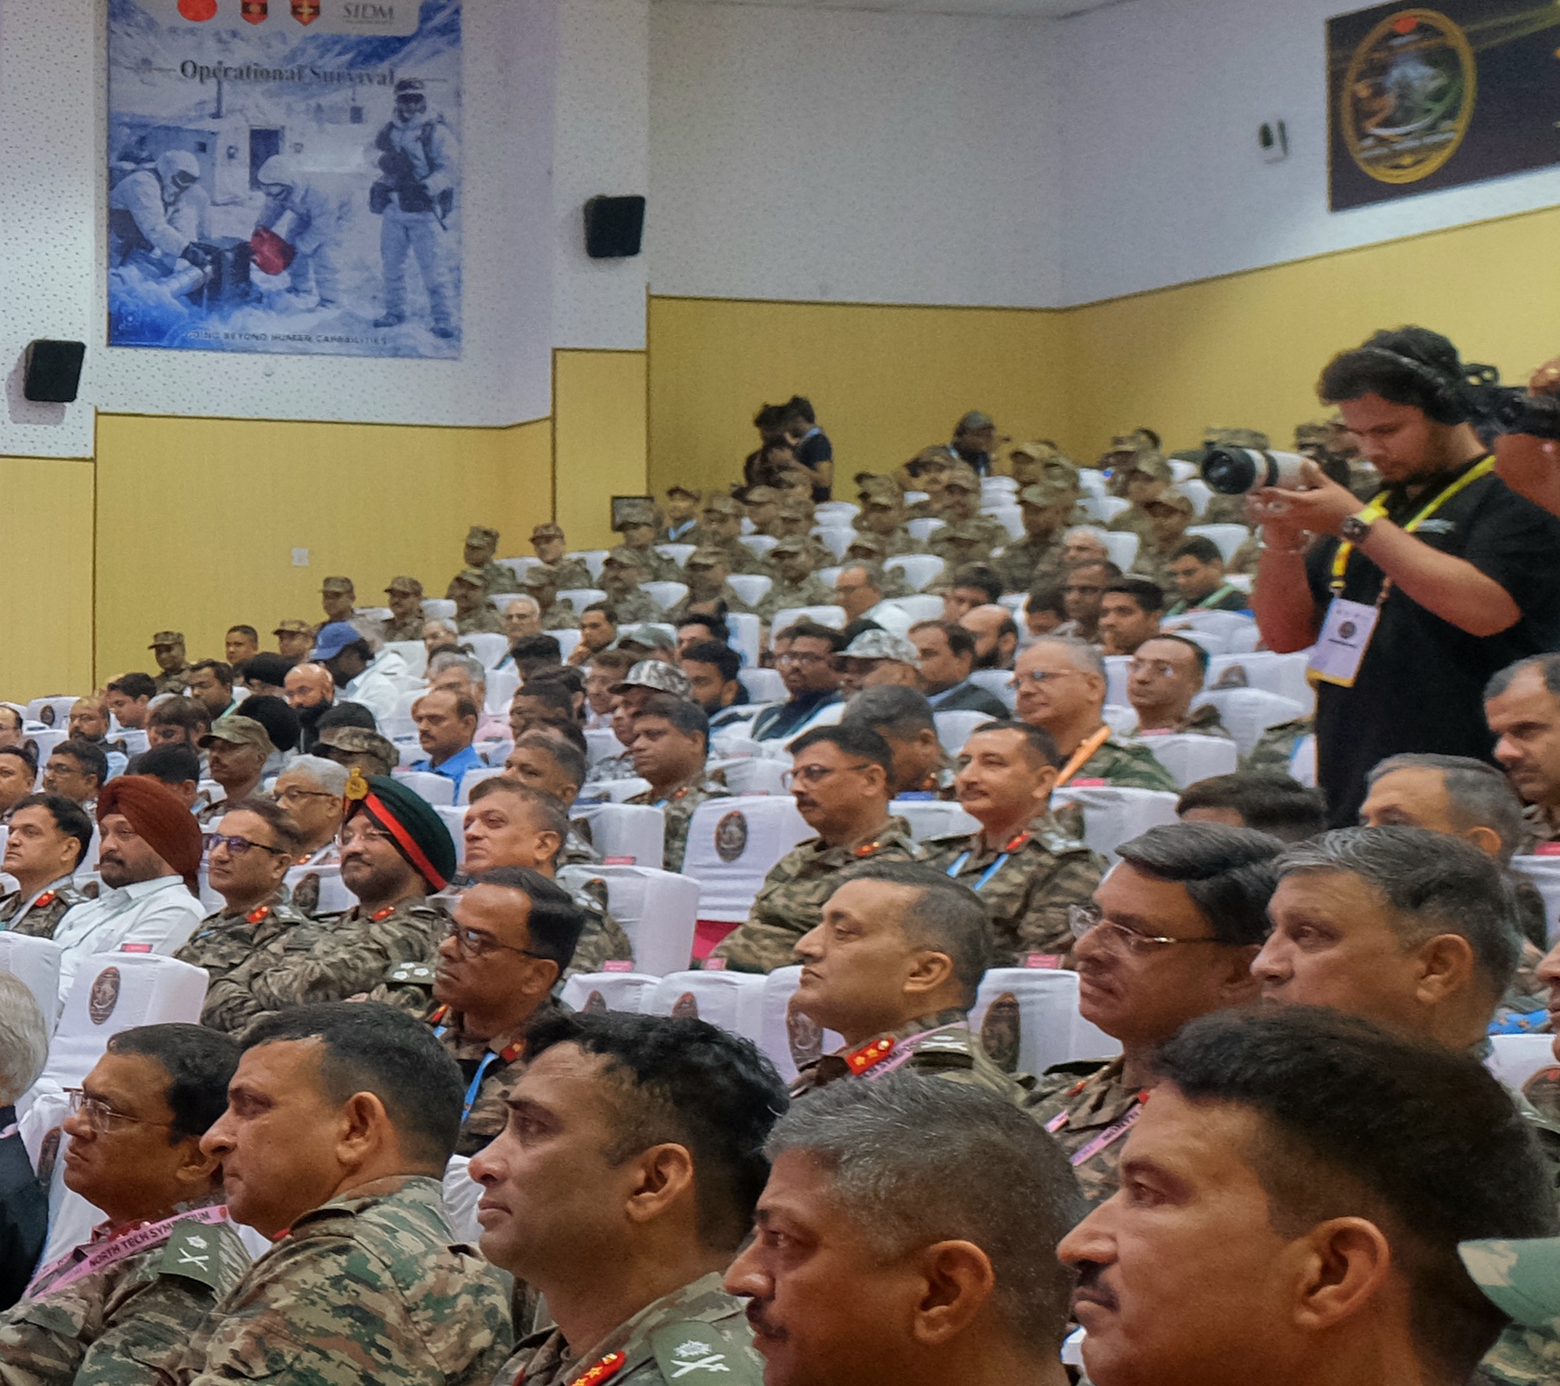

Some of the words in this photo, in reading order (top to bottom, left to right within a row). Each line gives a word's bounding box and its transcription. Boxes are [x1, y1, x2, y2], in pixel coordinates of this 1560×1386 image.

[342, 2, 394, 19] SIDM
[180, 59, 304, 82] Operational
[310, 67, 395, 86] Survival
[89, 1245, 121, 1267] NORTH
[120, 1231, 150, 1250] TECH
